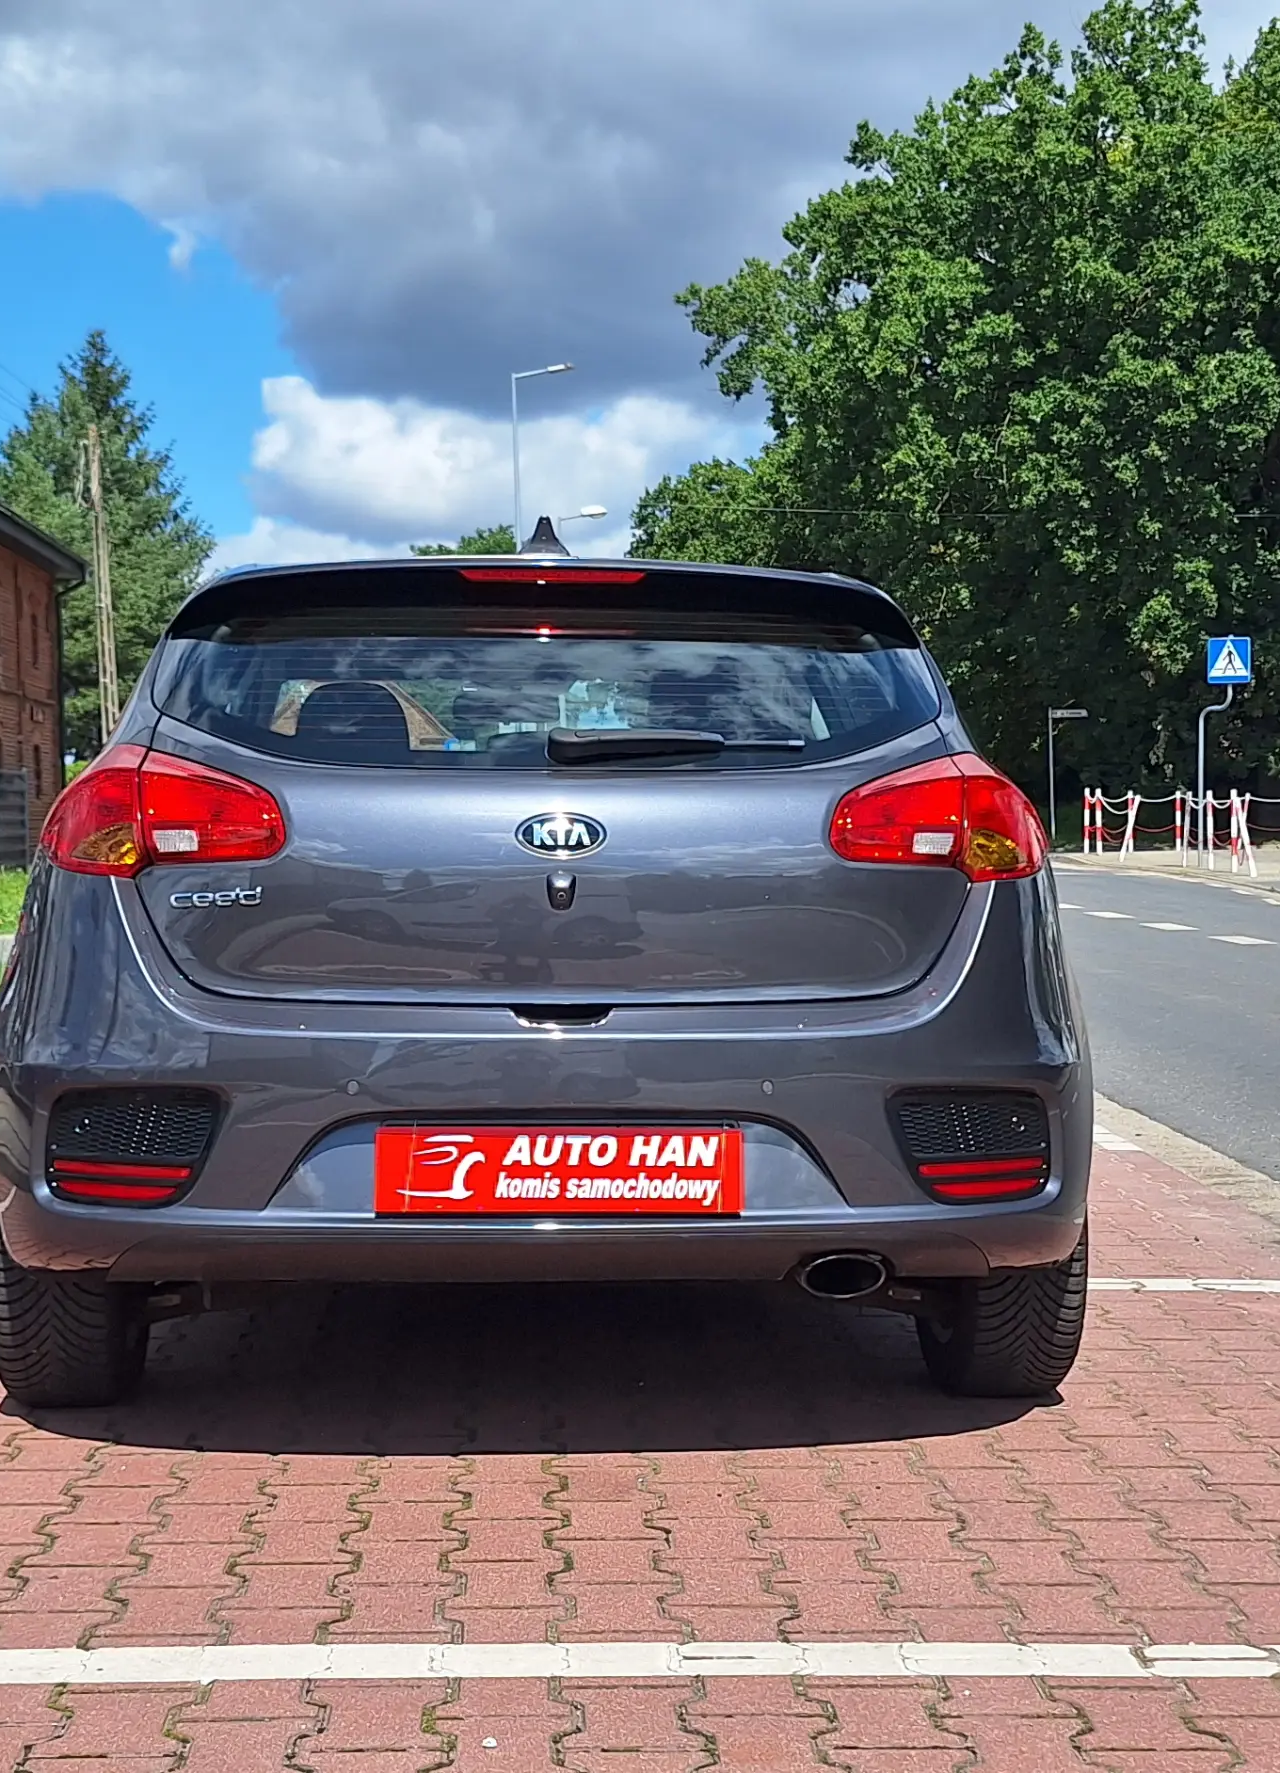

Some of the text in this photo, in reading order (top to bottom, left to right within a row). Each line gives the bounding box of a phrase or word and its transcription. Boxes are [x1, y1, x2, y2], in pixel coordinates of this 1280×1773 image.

[532, 819, 591, 846] KIA
[502, 1134, 720, 1168] AUTO HAN
[495, 1172, 720, 1207] komis samochodowy
